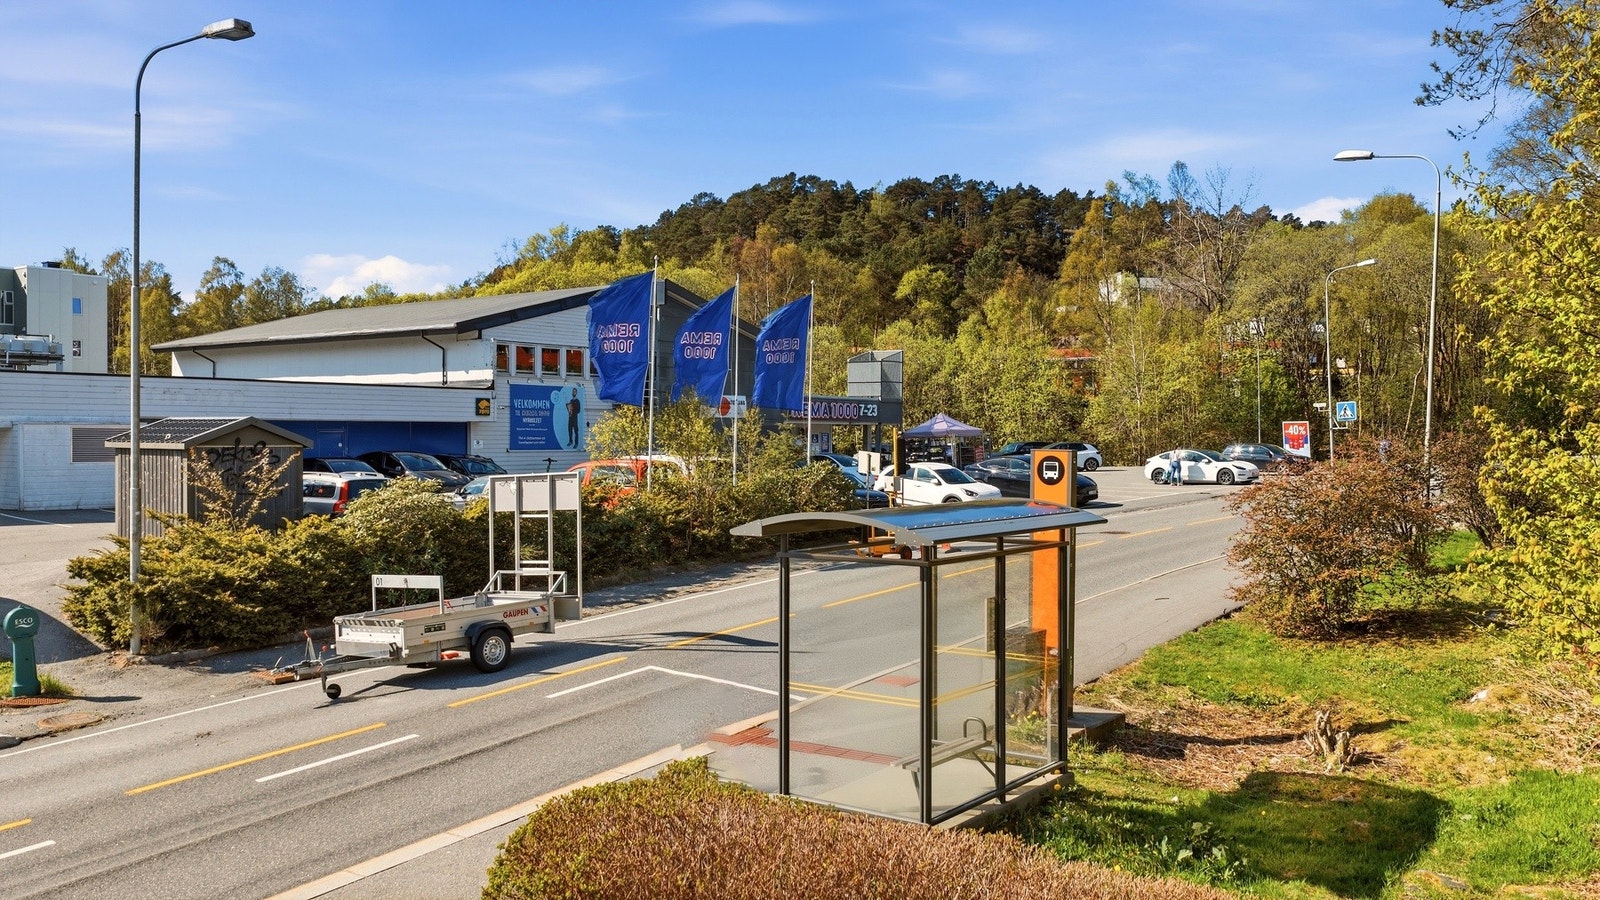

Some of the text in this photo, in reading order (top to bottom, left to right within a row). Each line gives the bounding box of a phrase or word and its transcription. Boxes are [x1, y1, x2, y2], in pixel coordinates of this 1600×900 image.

[513, 398, 551, 409] VELKOMMEN
[831, 402, 859, 419] 1000
[859, 404, 878, 417] 7-23
[1285, 425, 1306, 434] -40%
[375, 577, 383, 586] 01
[502, 608, 529, 618] GAUPEN
[14, 616, 33, 625] ESCO
